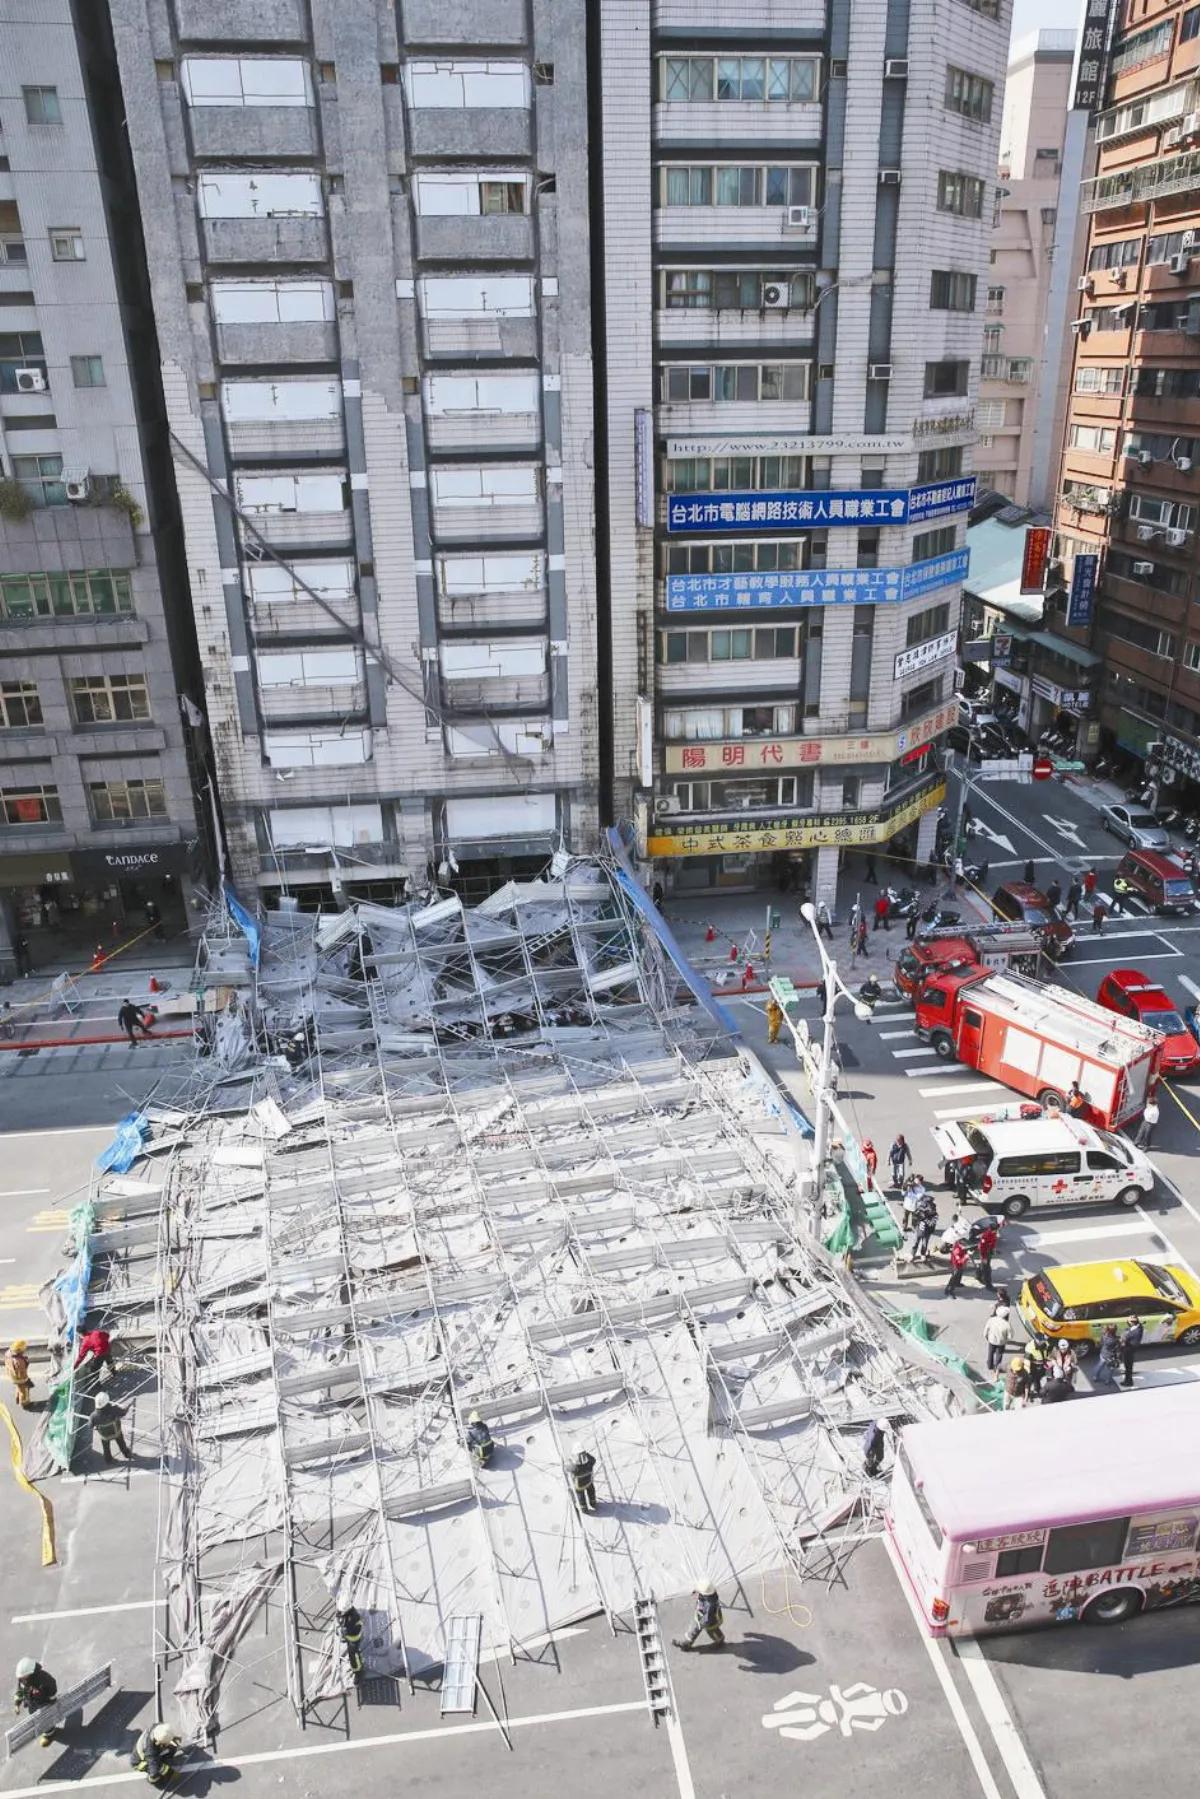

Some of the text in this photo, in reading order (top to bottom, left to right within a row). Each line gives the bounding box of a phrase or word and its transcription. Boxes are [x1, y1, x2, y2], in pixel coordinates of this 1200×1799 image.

[1076, 90, 1096, 104] 12F
[682, 744, 822, 769] 陽明代書
